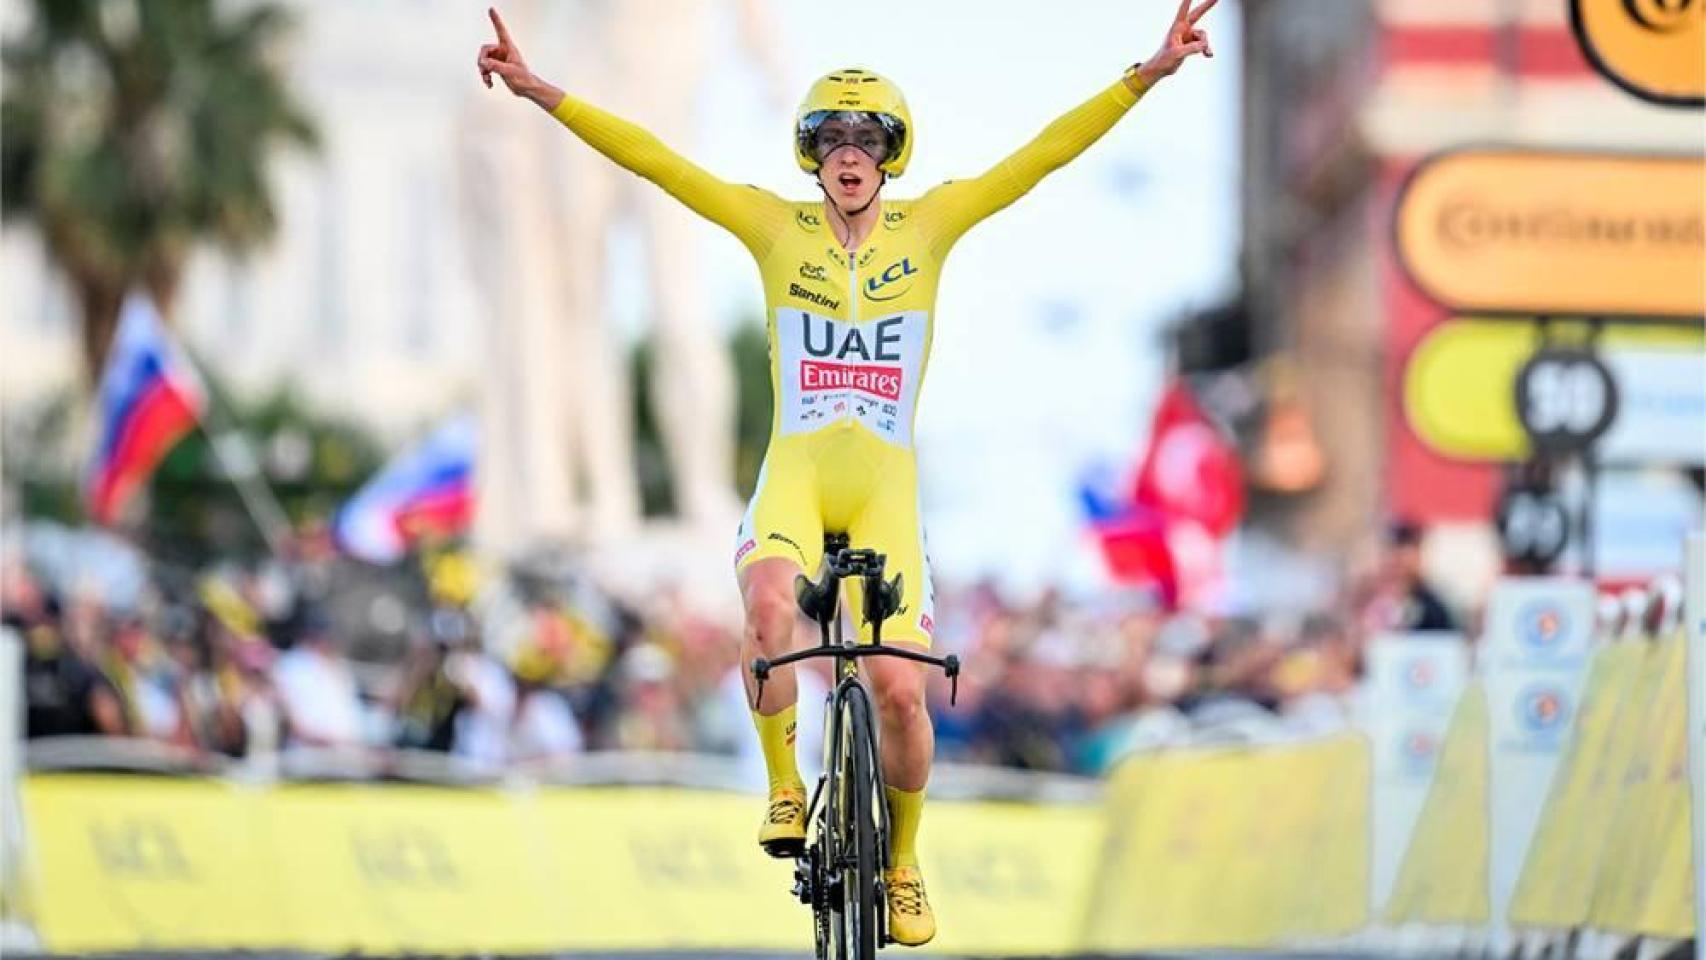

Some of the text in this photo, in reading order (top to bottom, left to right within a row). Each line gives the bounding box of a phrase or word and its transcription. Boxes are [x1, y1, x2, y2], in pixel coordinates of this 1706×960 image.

[869, 257, 918, 291] LCL
[789, 281, 840, 310] Santini
[803, 312, 904, 360] UAE
[804, 364, 899, 396] Emirates
